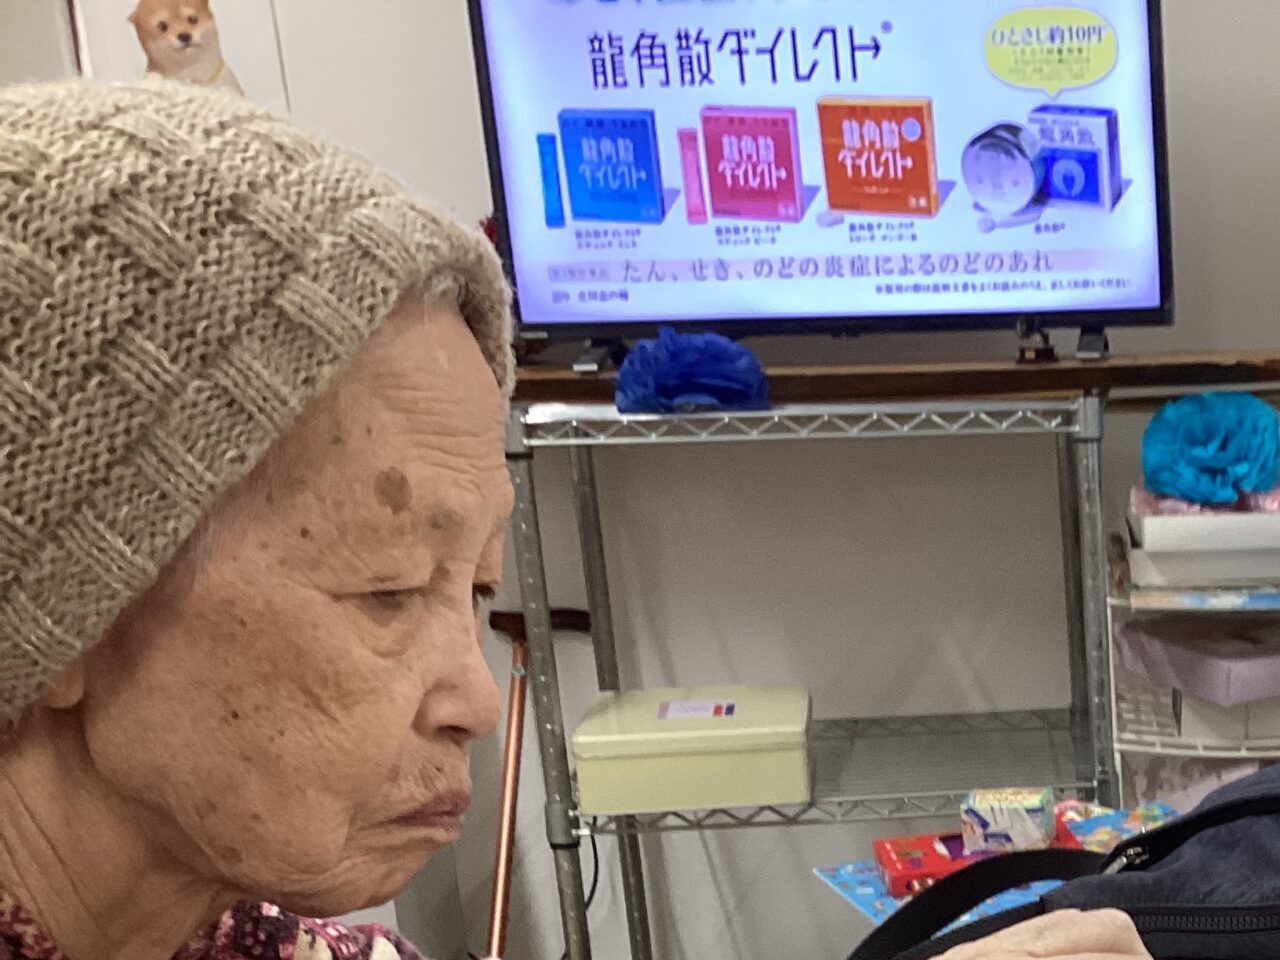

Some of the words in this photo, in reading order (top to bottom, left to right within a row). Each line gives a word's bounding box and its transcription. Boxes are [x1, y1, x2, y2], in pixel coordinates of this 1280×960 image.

[588, 26, 881, 88] 龍角散ダイレクト
